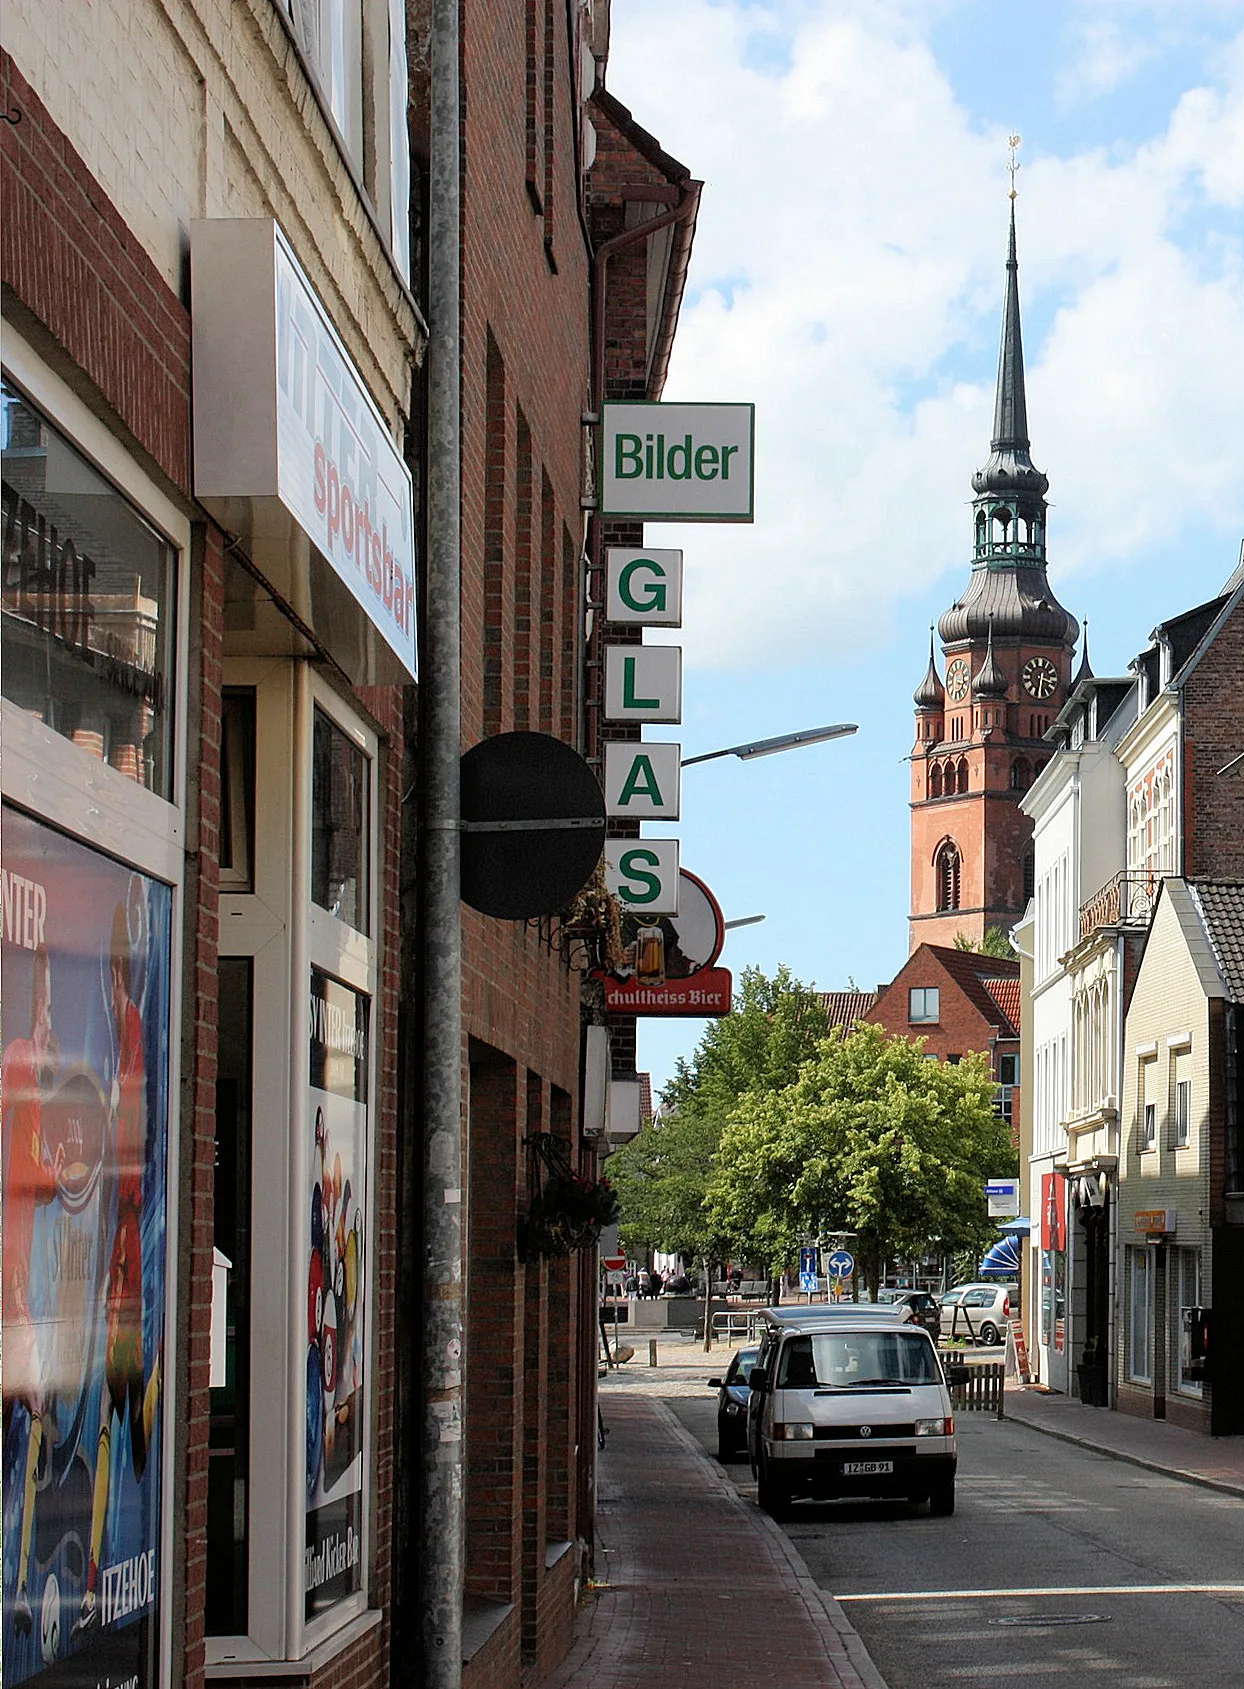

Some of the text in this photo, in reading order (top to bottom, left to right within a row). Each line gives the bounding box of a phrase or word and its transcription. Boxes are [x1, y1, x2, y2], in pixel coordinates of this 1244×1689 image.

[615, 433, 738, 480] Bilder
[314, 441, 413, 637] sportsbar
[606, 989, 721, 1005] chultheiss Bier
[102, 1549, 155, 1627] ITZEHOE
